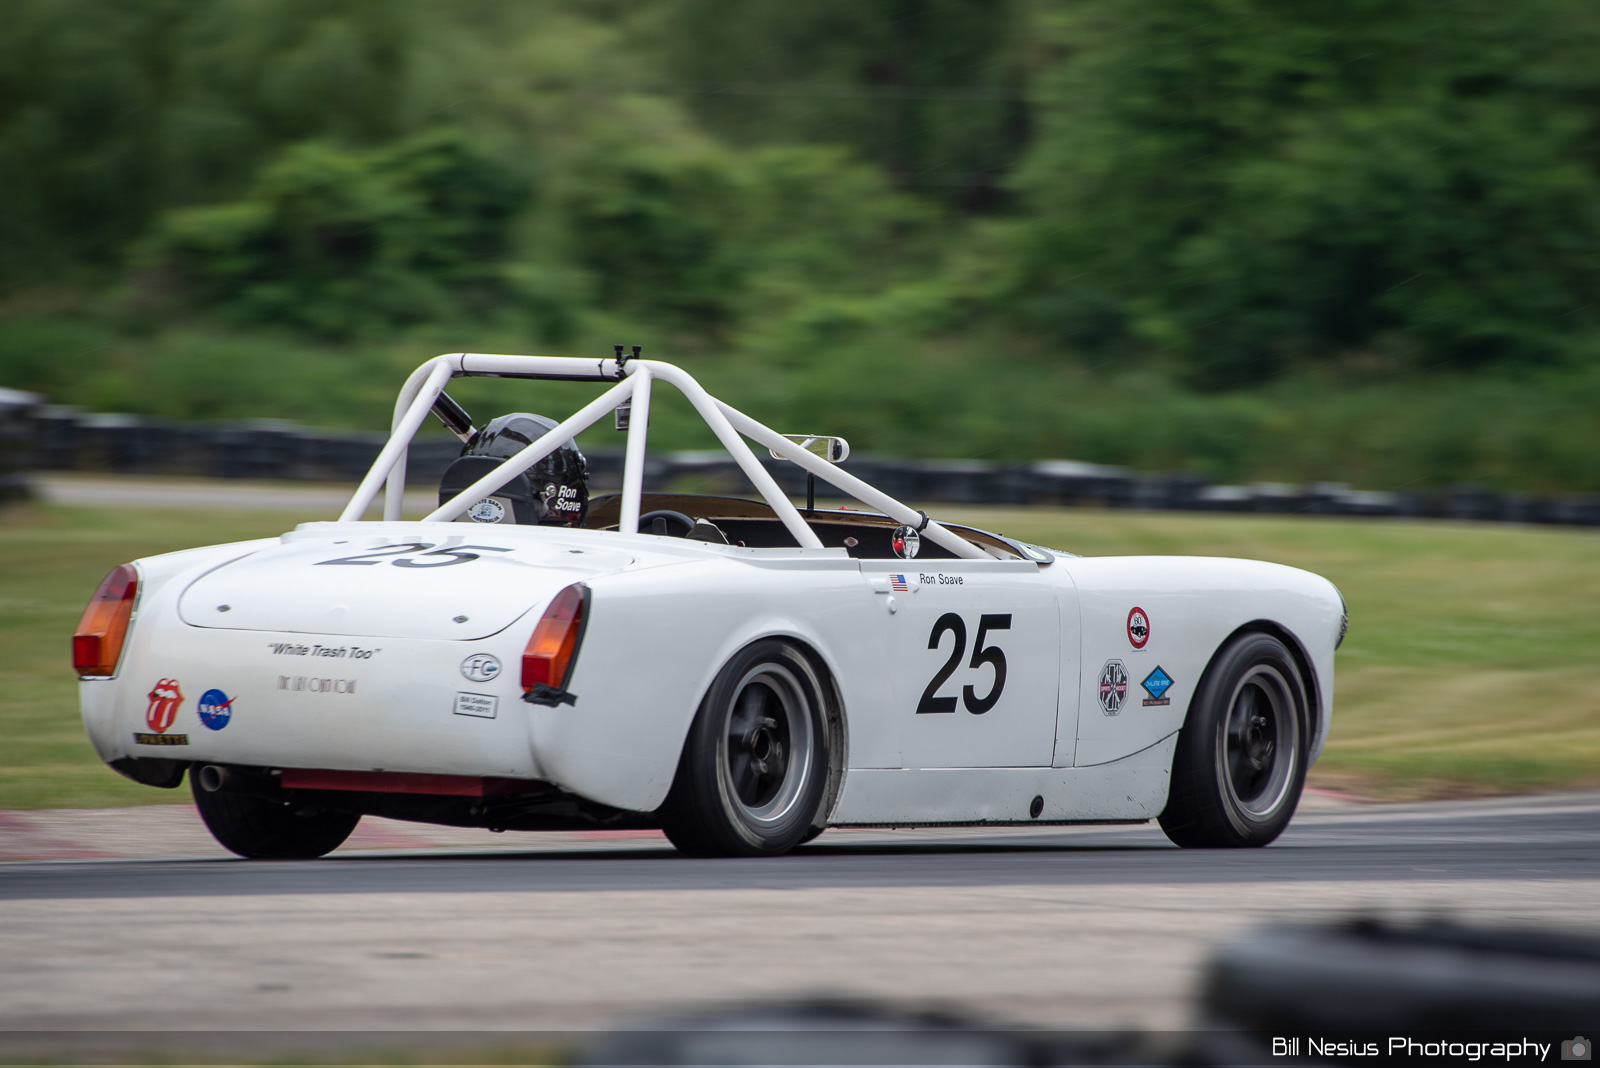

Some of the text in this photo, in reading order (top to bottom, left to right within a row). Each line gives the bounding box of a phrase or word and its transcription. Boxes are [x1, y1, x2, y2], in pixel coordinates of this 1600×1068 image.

[558, 485, 577, 498] Ron
[555, 498, 581, 512] Soave
[312, 542, 516, 568] 25
[919, 573, 964, 585] Ron Soave
[311, 644, 347, 658] Trash
[915, 612, 1013, 715] 25
[199, 703, 231, 717] NASA
